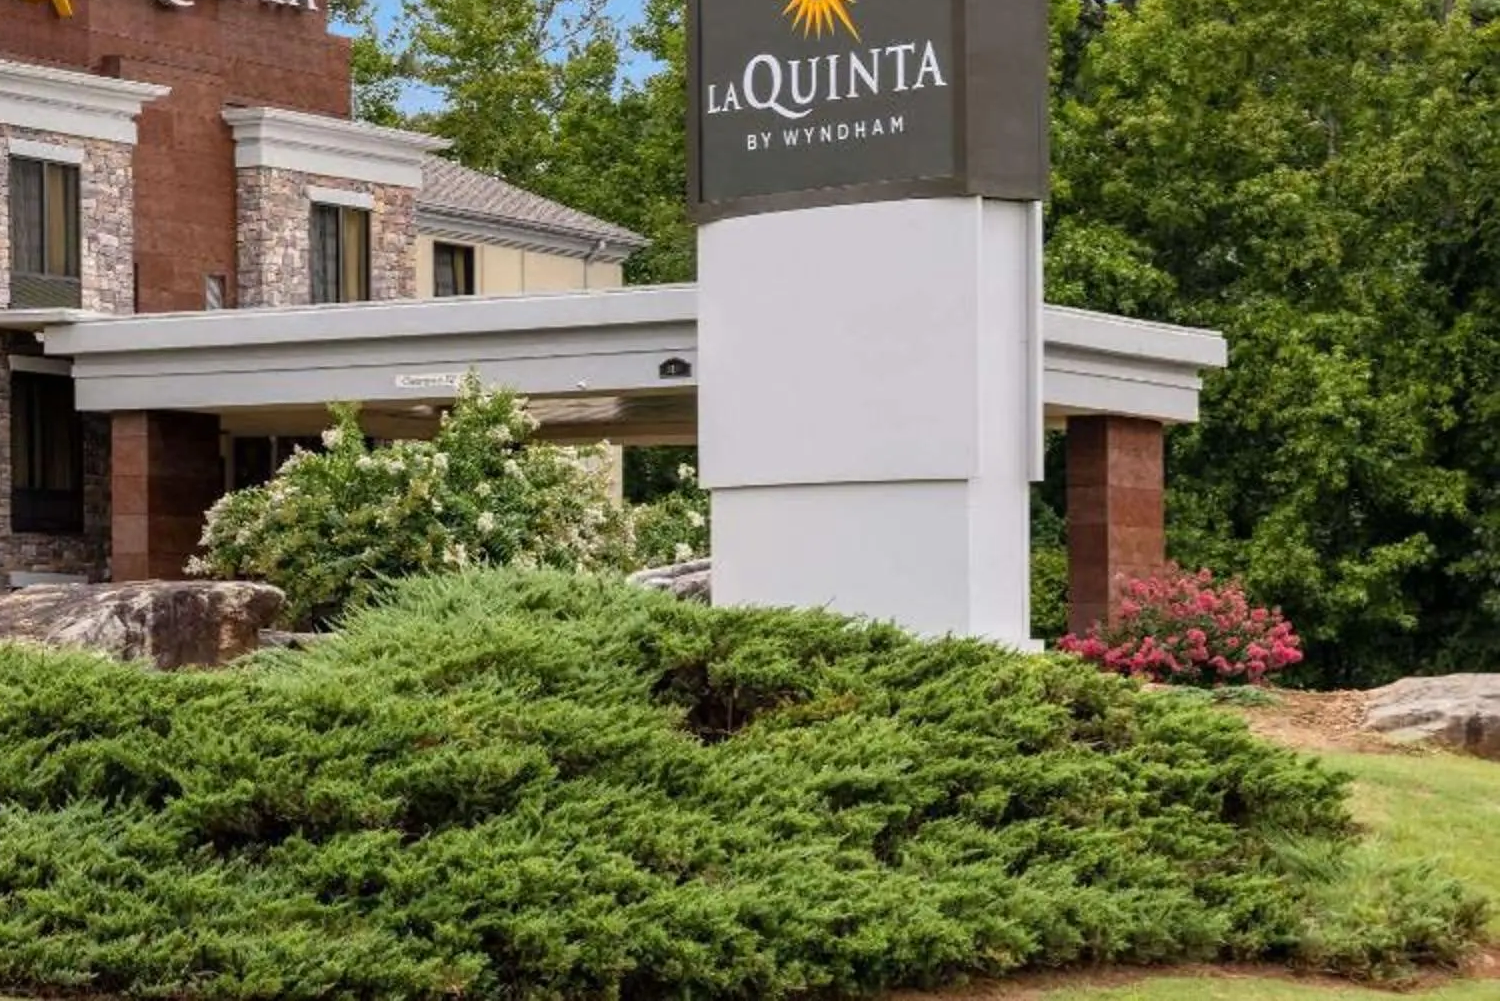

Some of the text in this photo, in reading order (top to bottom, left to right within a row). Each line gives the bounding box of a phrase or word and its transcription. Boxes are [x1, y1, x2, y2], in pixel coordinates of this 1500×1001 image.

[707, 39, 948, 120] LA QUINTA
[747, 116, 905, 151] BY WYNDHAM
